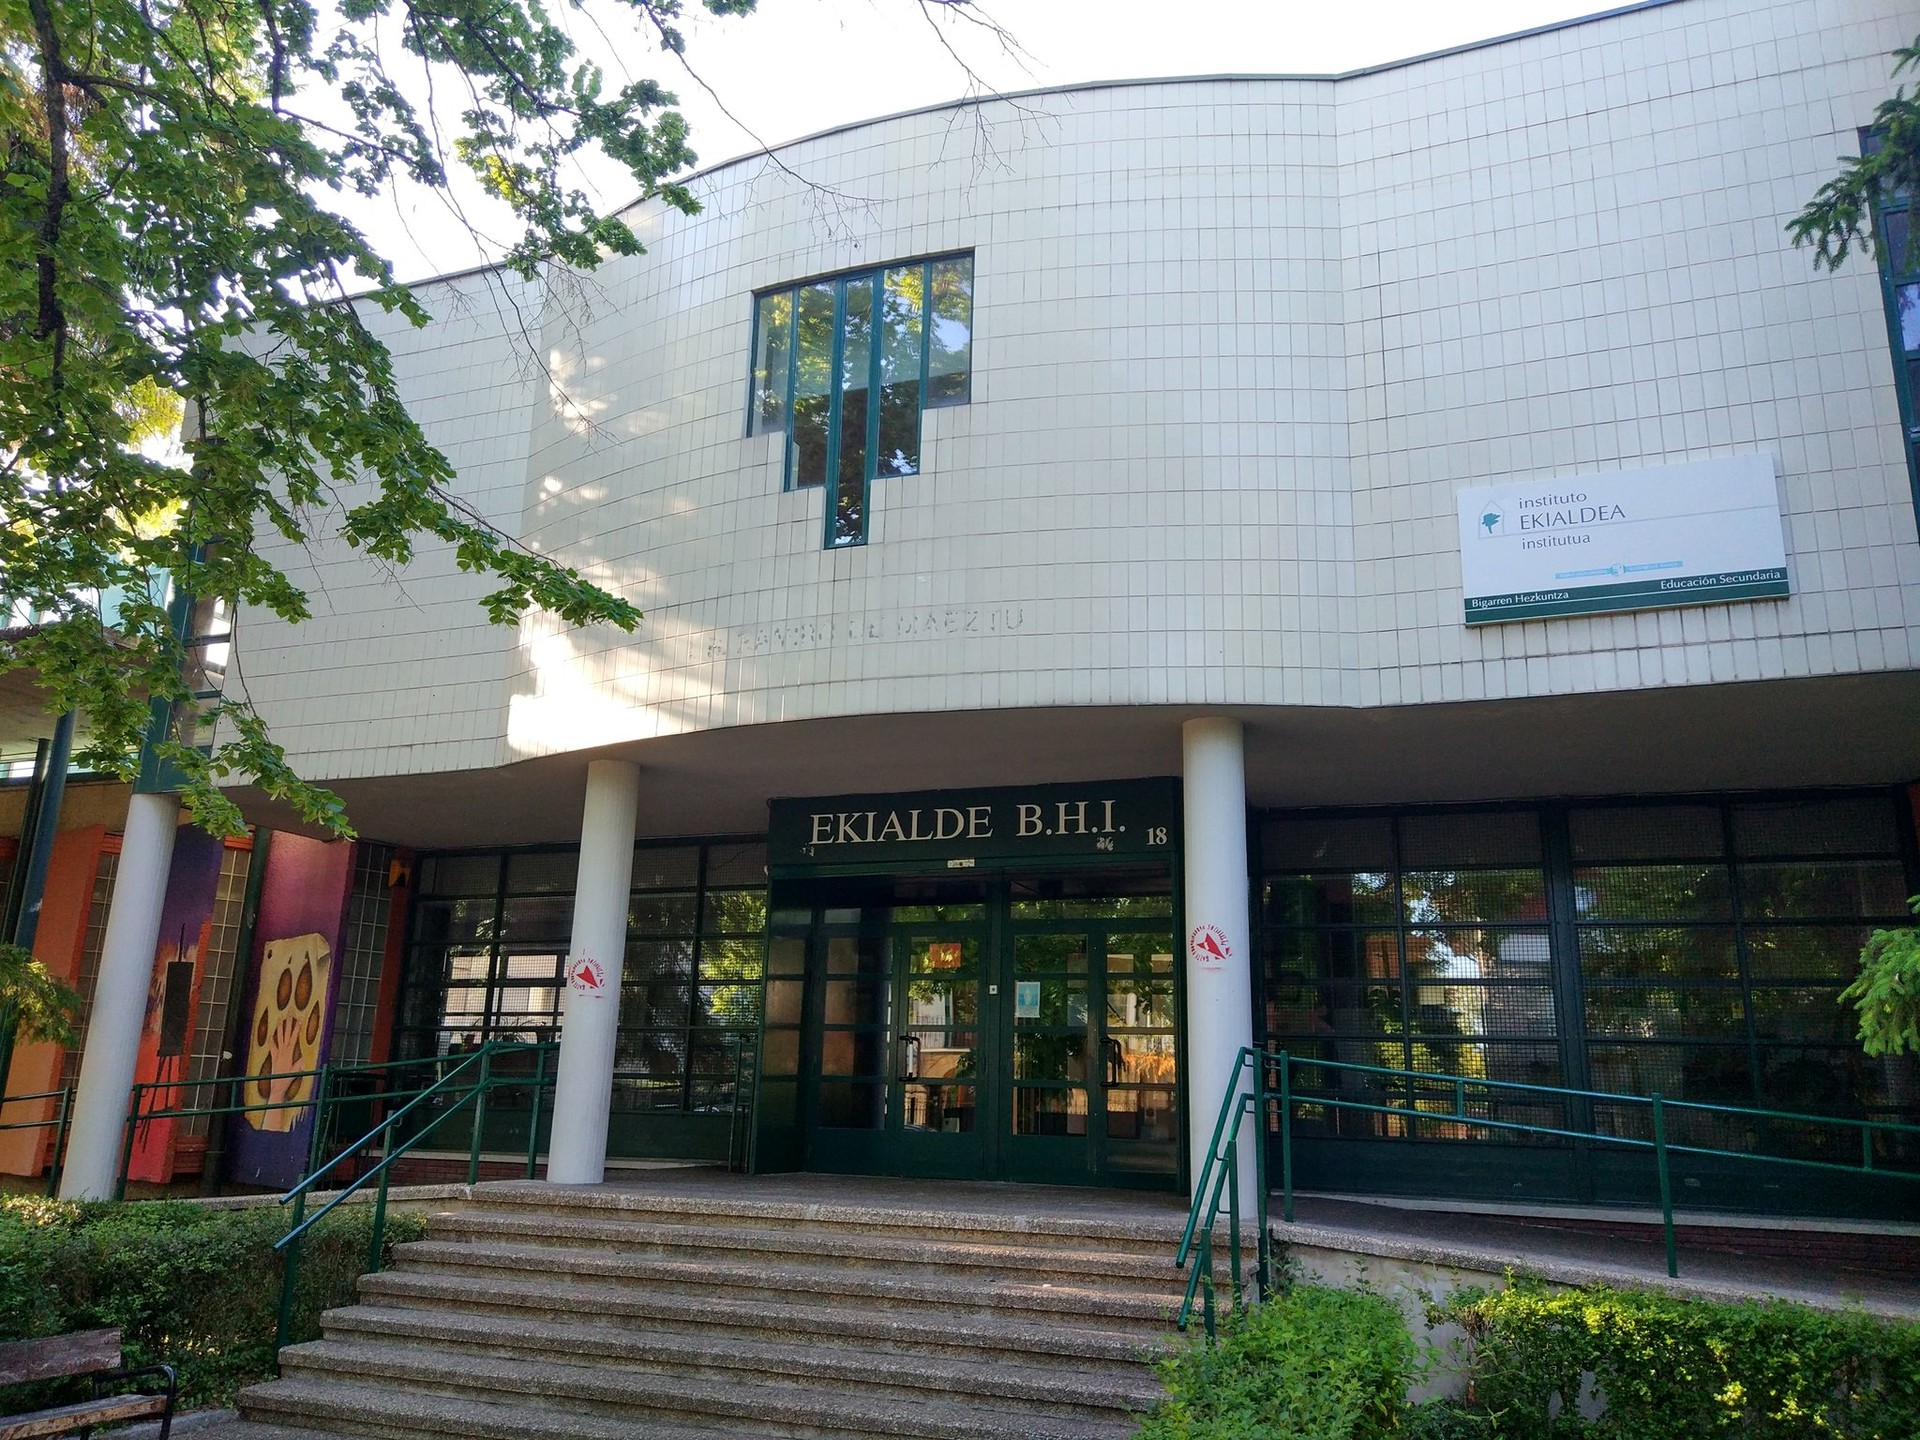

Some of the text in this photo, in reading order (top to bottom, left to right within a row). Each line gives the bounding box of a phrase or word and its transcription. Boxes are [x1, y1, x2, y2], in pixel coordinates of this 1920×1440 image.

[1519, 493, 1587, 509] instituto
[1520, 504, 1626, 530] EKIALDEA
[1522, 534, 1591, 550] institutua
[1660, 569, 1781, 590] Educación Secundaria
[1472, 591, 1569, 609] Bigarren Hezkuntza
[809, 800, 1126, 846] EKIALDE B.H.I.
[1146, 826, 1168, 846] 18
